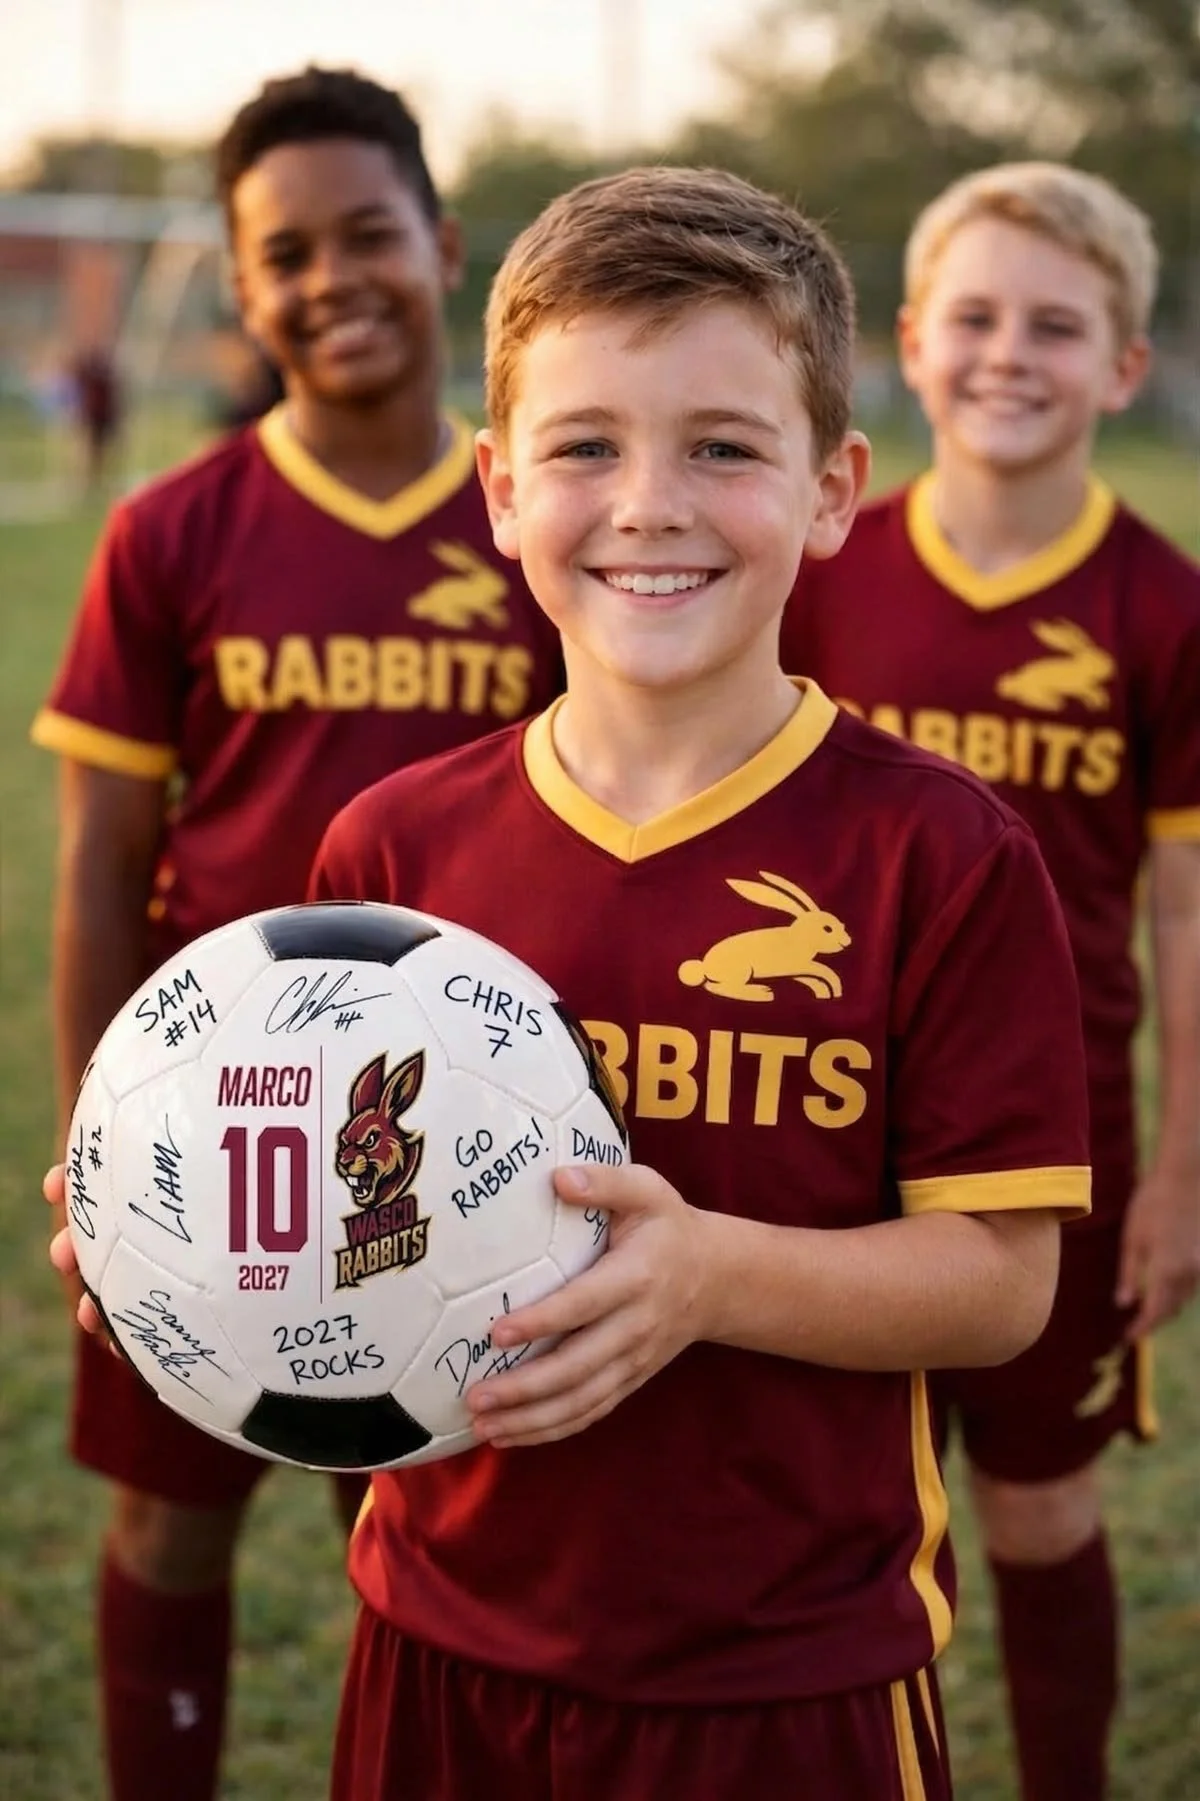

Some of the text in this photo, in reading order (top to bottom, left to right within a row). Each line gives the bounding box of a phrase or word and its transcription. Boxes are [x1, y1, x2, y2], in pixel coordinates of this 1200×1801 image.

[215, 635, 534, 717] RABBITS
[834, 697, 1123, 796] BBITS
[135, 969, 203, 1033] SAM
[164, 999, 218, 1048] #14
[444, 975, 543, 1036] CHRIS
[484, 1024, 512, 1058] 7
[217, 1066, 313, 1107] MARCO
[451, 1116, 550, 1219] RABBITS!
[456, 1129, 494, 1168] GO
[571, 1127, 624, 1168] DAVID
[219, 1126, 309, 1253] 10
[348, 1197, 416, 1248] WASCO
[239, 1264, 290, 1292] 2027
[338, 1221, 427, 1286] RABBITS
[273, 1313, 359, 1354] 2027
[434, 1291, 512, 1398] Dav
[289, 1343, 386, 1386] ROCKS
